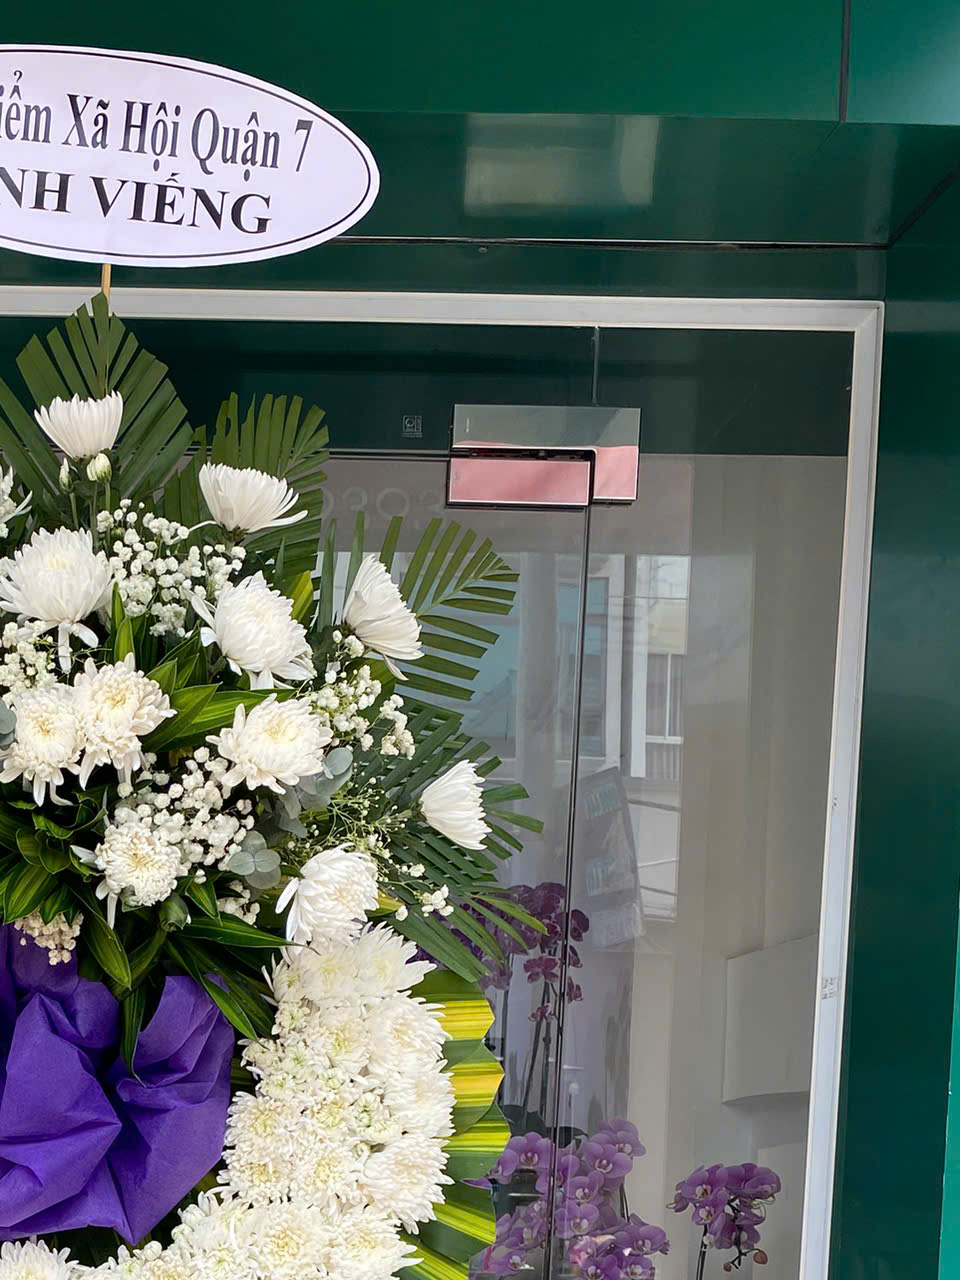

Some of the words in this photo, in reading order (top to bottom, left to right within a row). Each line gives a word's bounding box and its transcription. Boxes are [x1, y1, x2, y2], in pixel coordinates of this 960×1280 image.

[62, 93, 109, 149] Xã
[119, 100, 181, 171] Hội
[191, 108, 281, 181] Quận
[294, 119, 314, 173] 7
[89, 171, 272, 235] VIẾNG
